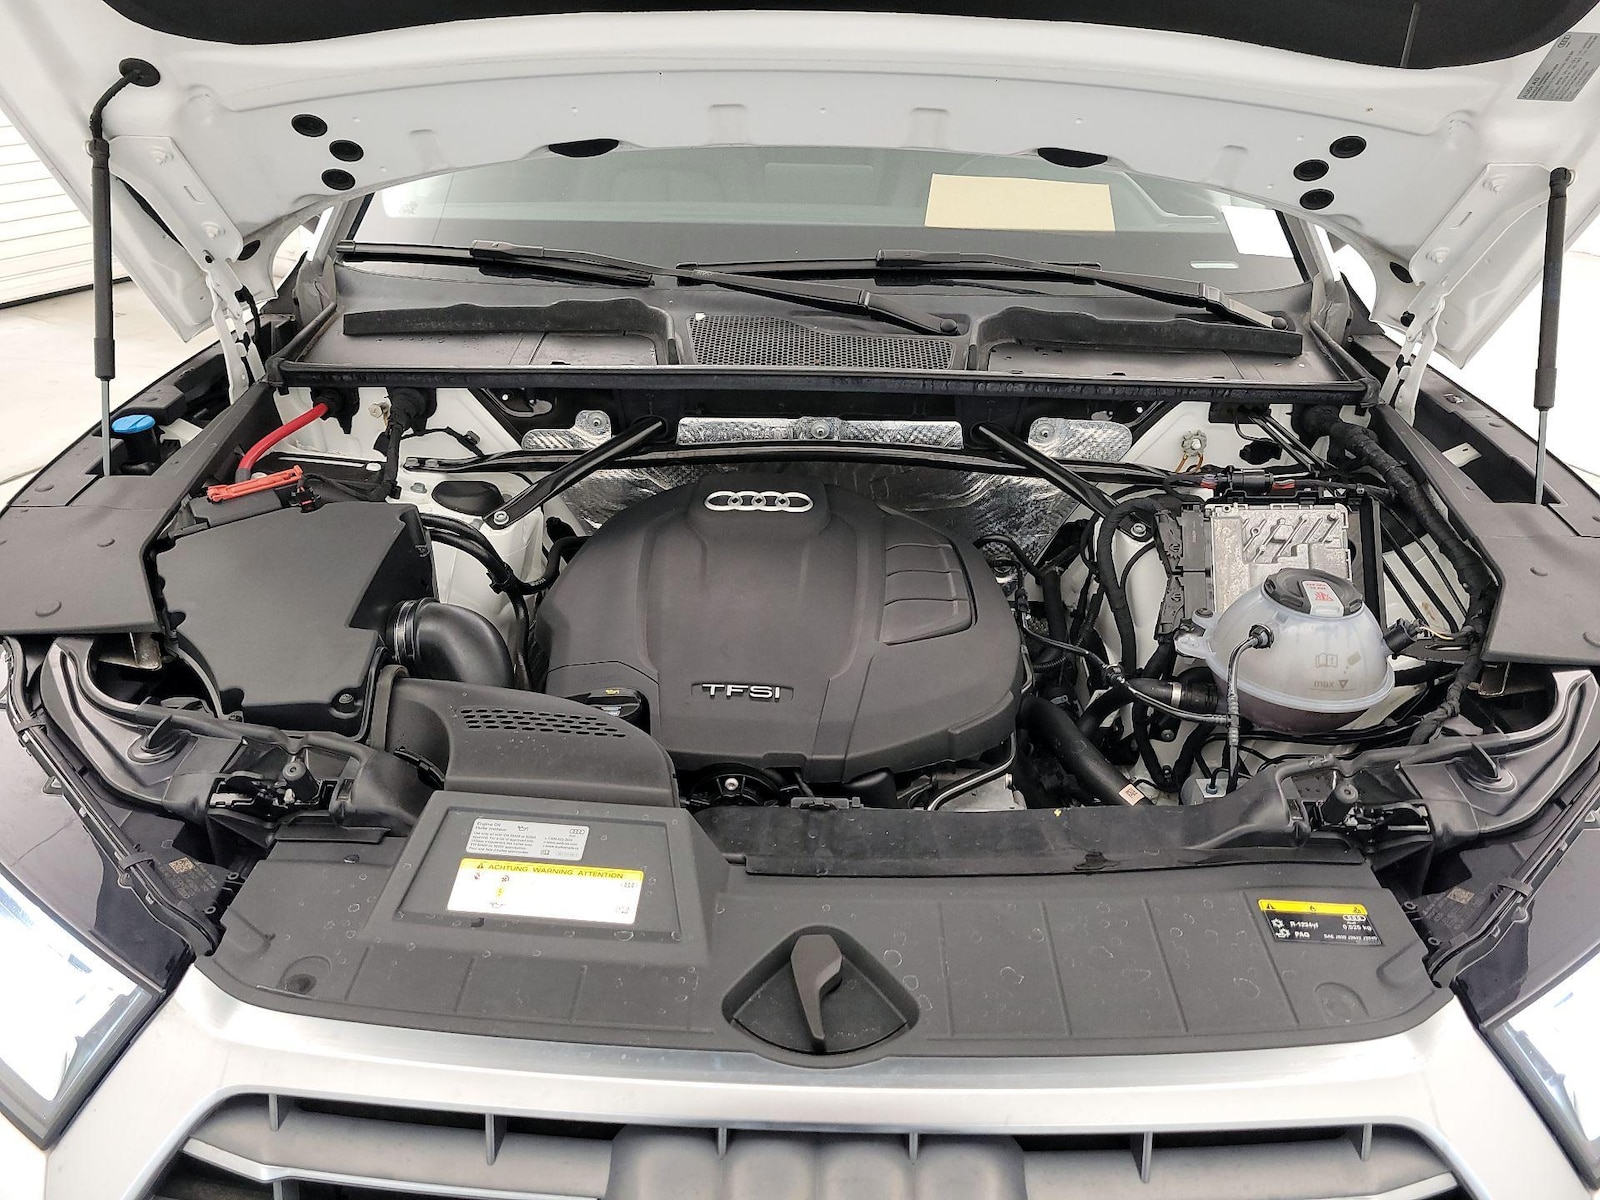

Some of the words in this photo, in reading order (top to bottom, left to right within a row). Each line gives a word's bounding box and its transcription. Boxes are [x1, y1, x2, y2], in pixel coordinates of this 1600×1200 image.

[1313, 680, 1335, 689] max
[701, 683, 780, 701] TFSI
[488, 864, 529, 872] ACHTUNG
[532, 867, 574, 875] WARNING
[577, 870, 624, 879] ATTENTION
[1294, 931, 1310, 939] PAG
